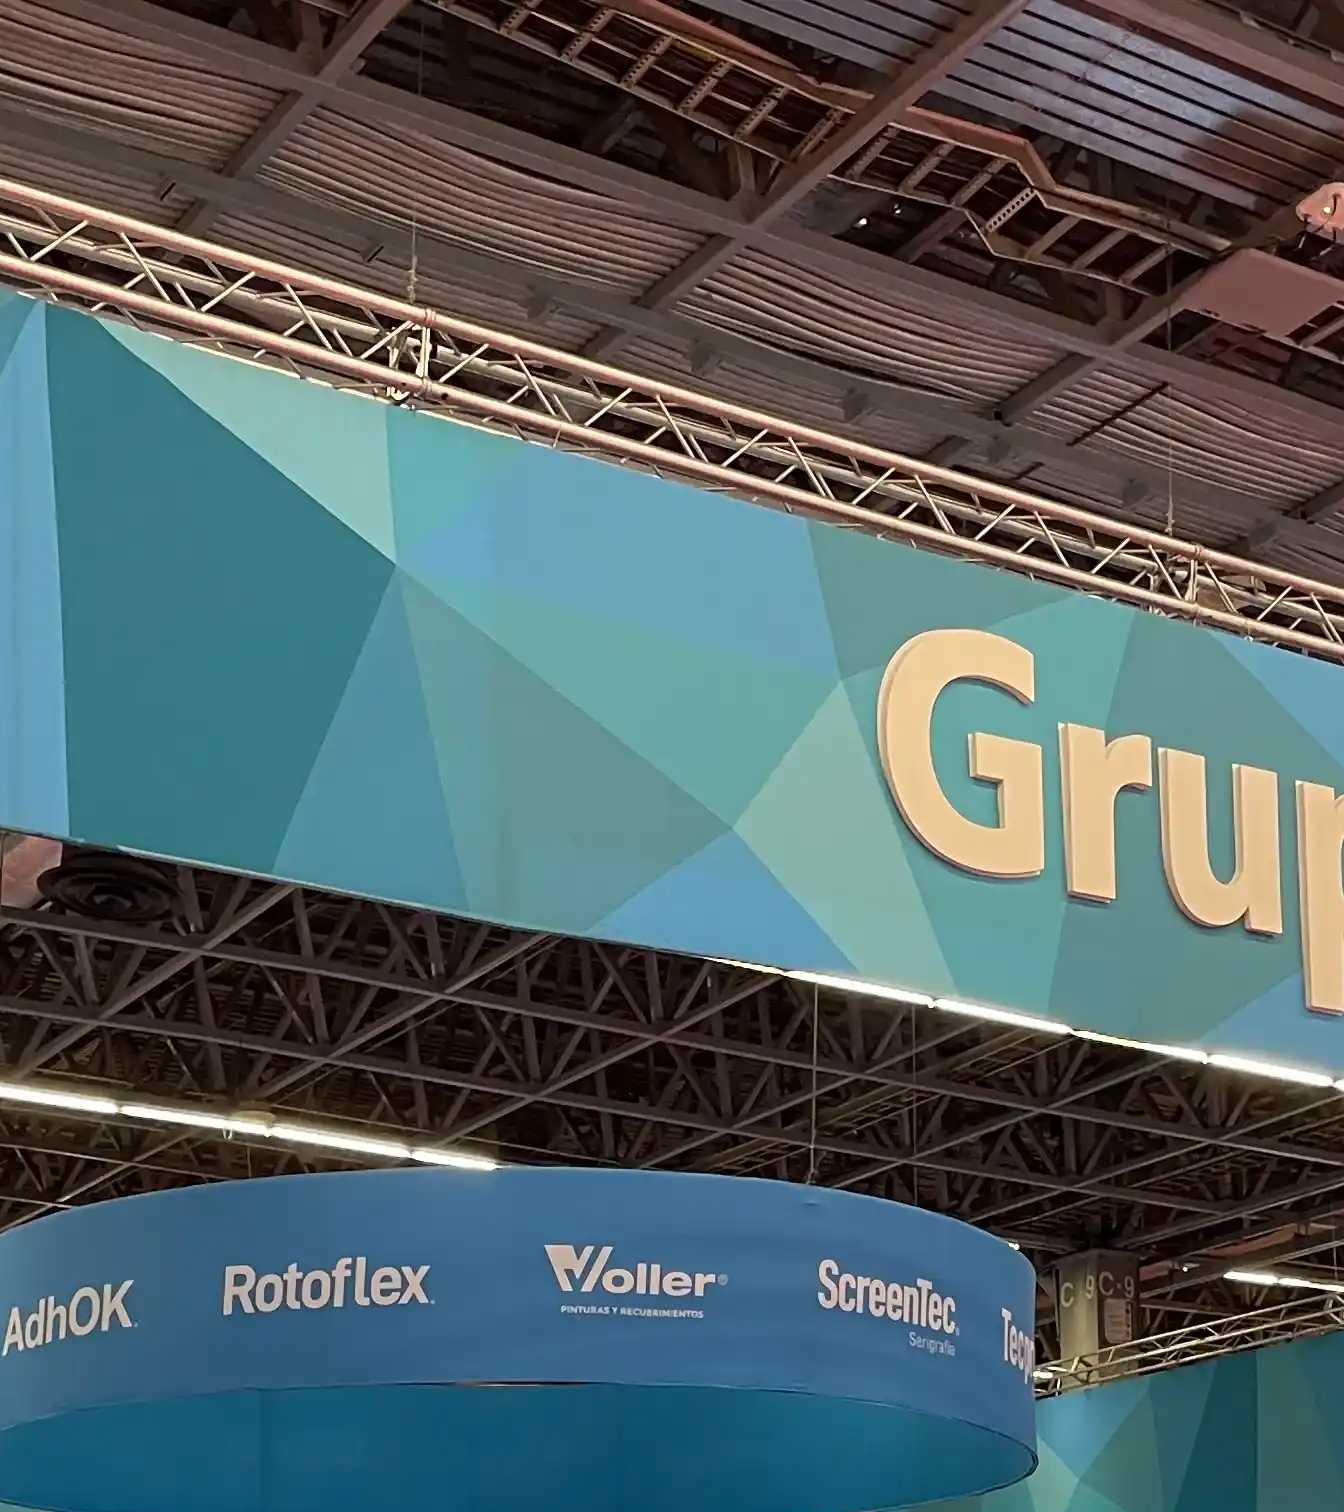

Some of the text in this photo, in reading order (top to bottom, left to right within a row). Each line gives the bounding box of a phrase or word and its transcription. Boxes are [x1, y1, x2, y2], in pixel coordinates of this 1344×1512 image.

[2, 1279, 135, 1357] AdhOK
[223, 1256, 431, 1316] Rotoflex
[561, 1305, 704, 1319] PINTURAS Y RECUBRIMIENTOS
[817, 1259, 957, 1334] ScreenTec
